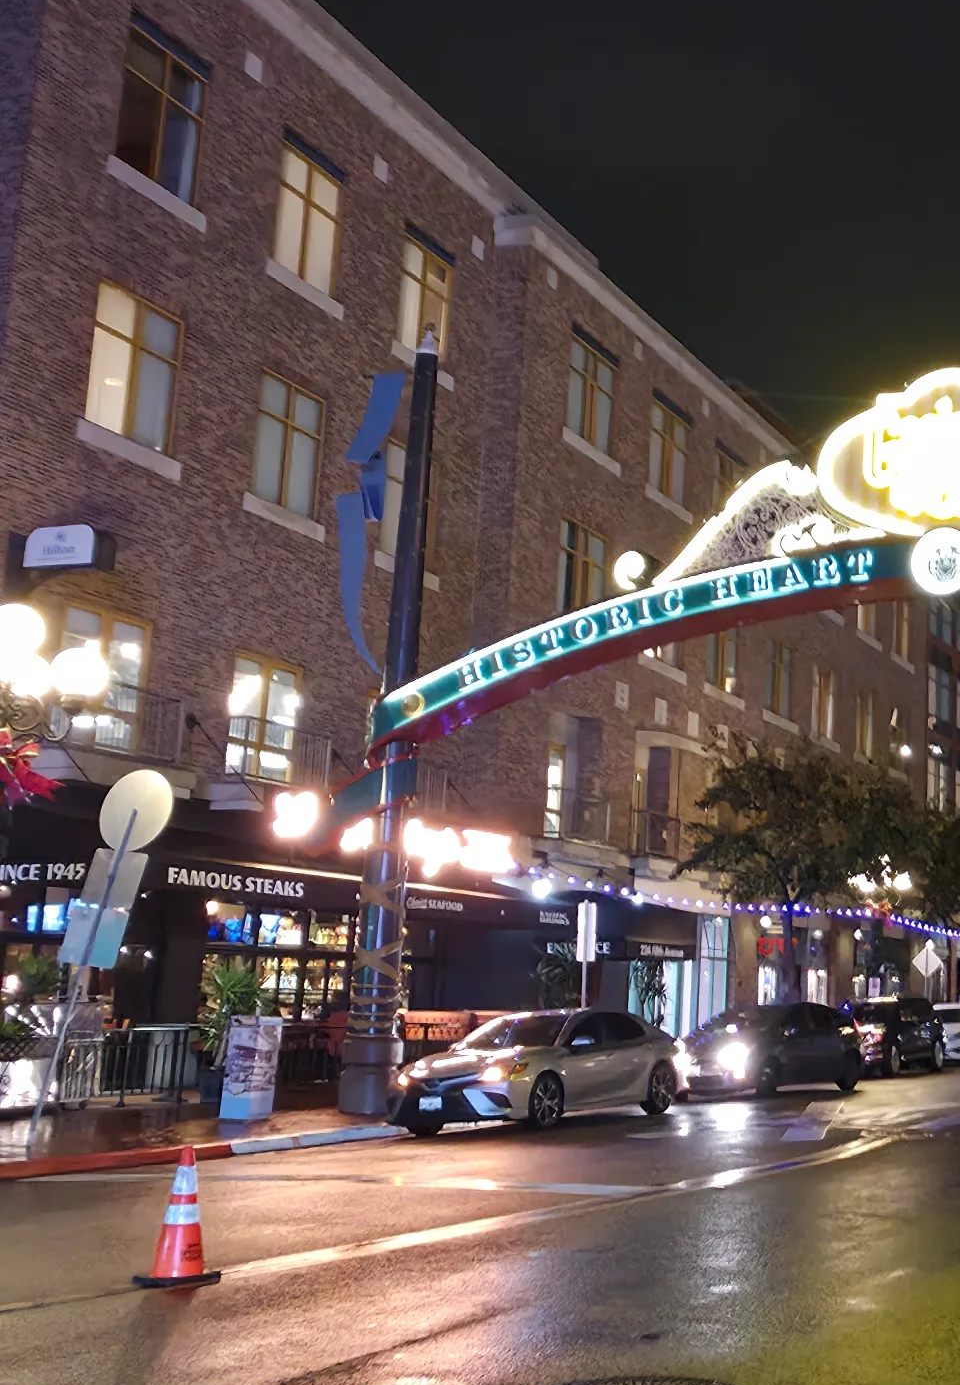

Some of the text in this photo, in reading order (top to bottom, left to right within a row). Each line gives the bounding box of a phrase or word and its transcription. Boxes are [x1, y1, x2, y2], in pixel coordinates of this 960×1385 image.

[458, 588, 685, 692] HISTORIC
[709, 547, 874, 608] HEART
[0, 863, 87, 881] INCE 1945
[168, 866, 305, 898] FAMOUS STEAKS
[546, 942, 611, 955] ENTCE
